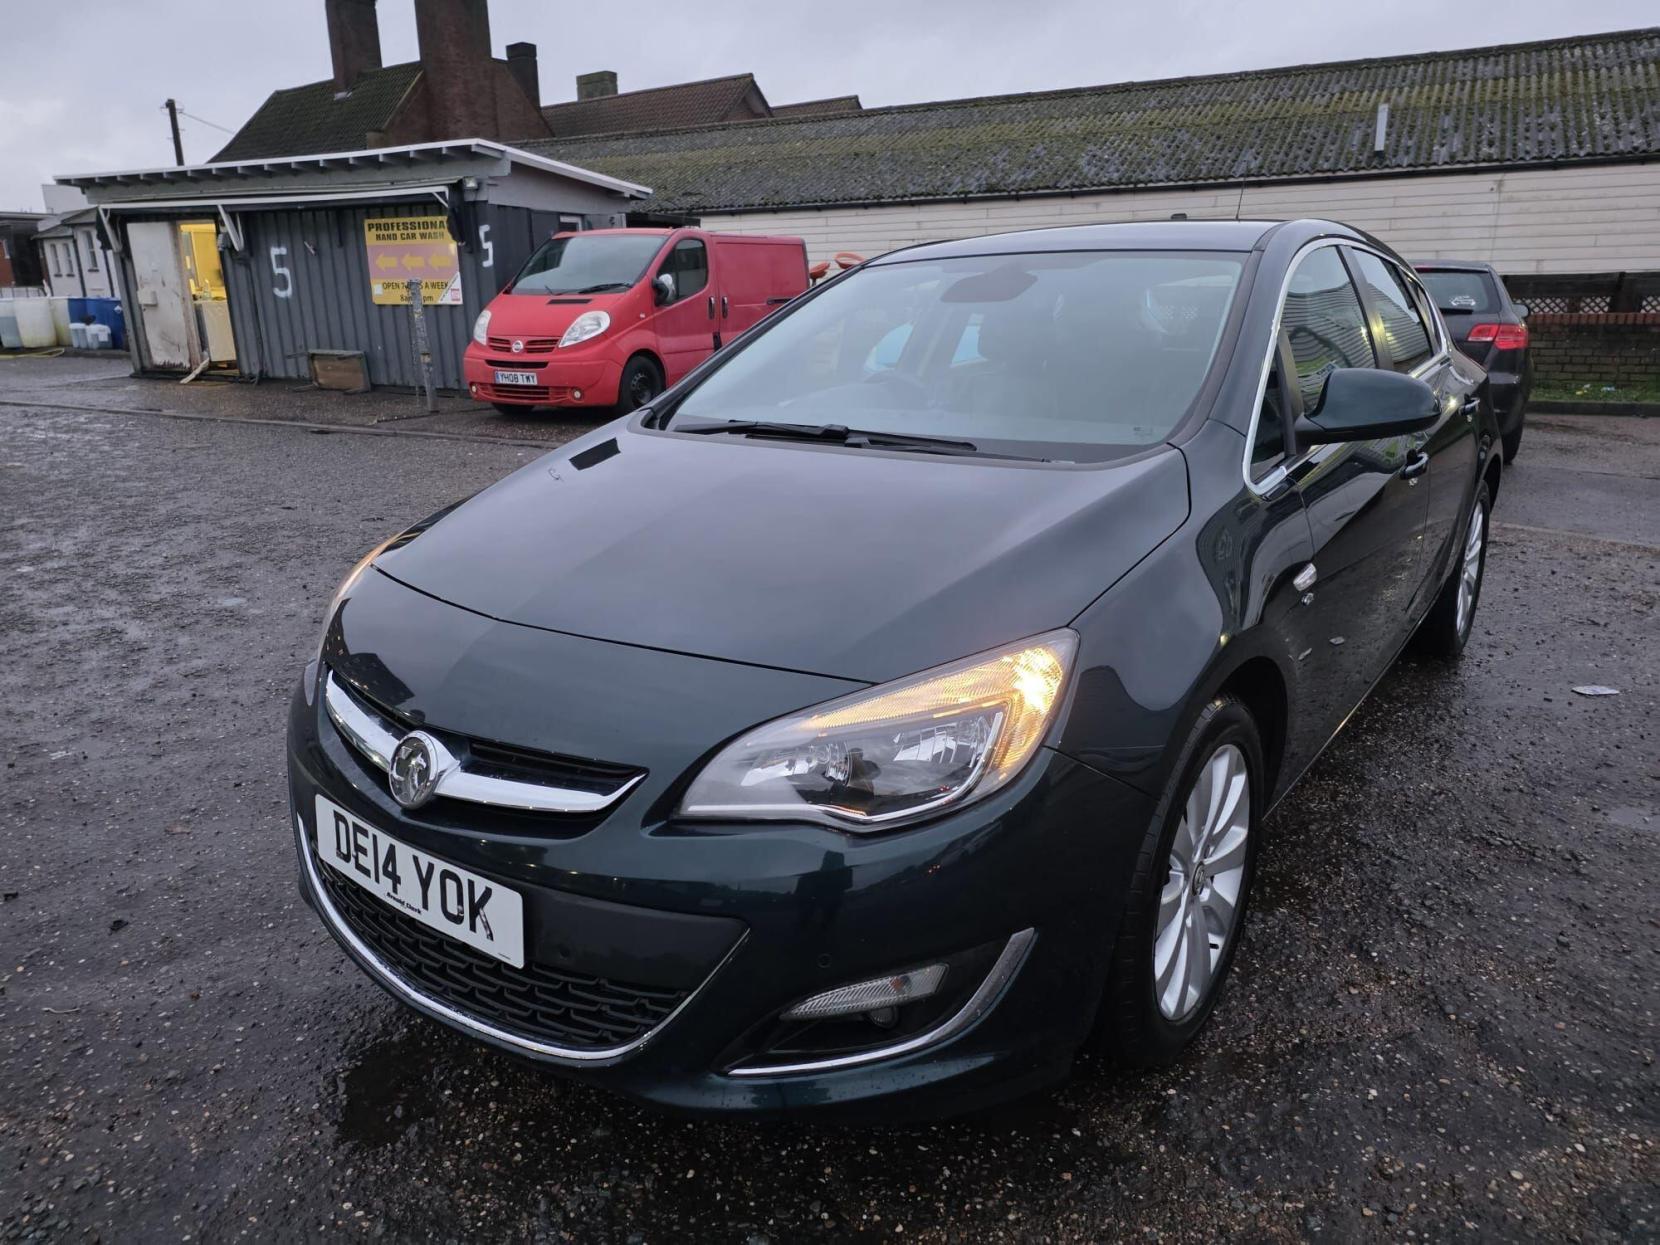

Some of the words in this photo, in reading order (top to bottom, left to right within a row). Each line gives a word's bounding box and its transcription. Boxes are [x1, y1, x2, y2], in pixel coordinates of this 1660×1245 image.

[367, 221, 446, 231] PROFESSIONA
[375, 233, 398, 241] HAND
[400, 232, 417, 240] CAR
[418, 231, 445, 240] WASH
[479, 224, 493, 267] 5
[270, 247, 293, 298] 5
[382, 281, 400, 290] OPEN
[424, 281, 430, 290] A
[431, 281, 449, 290] WEEK
[333, 810, 401, 895] DE14
[412, 854, 494, 942] YOK
